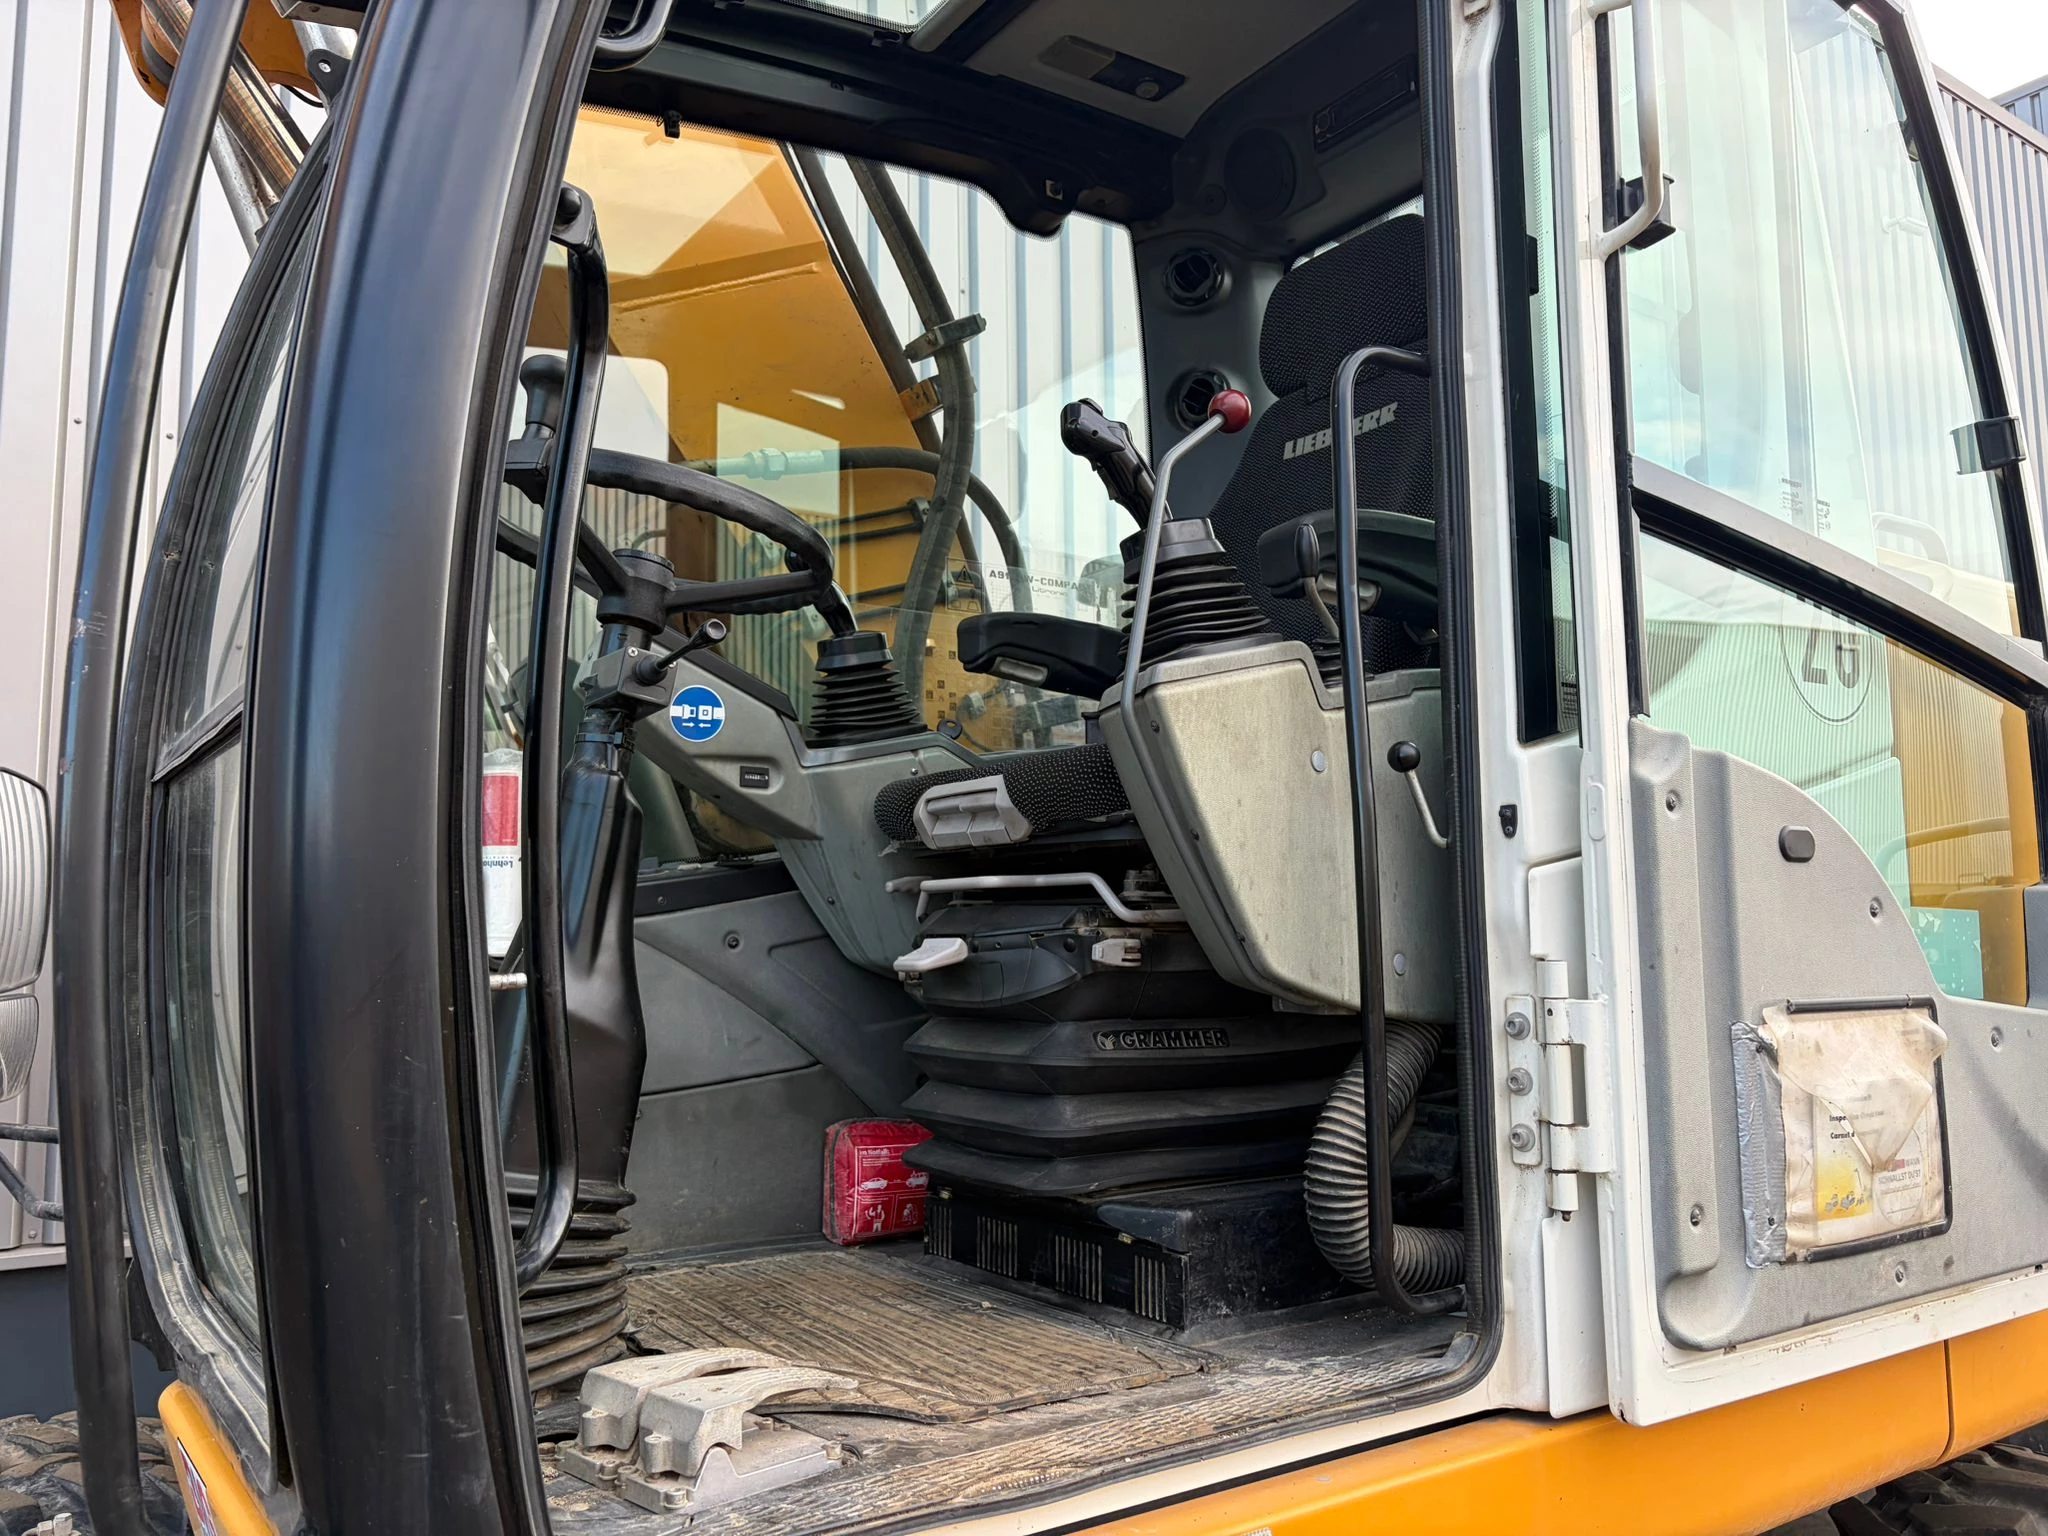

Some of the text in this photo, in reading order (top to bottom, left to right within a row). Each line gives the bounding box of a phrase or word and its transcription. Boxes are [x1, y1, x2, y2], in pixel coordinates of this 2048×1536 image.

[1283, 402, 1398, 460] LIEBERR
[482, 860, 514, 869] Lehnho
[1120, 1029, 1227, 1049] GRAMMER
